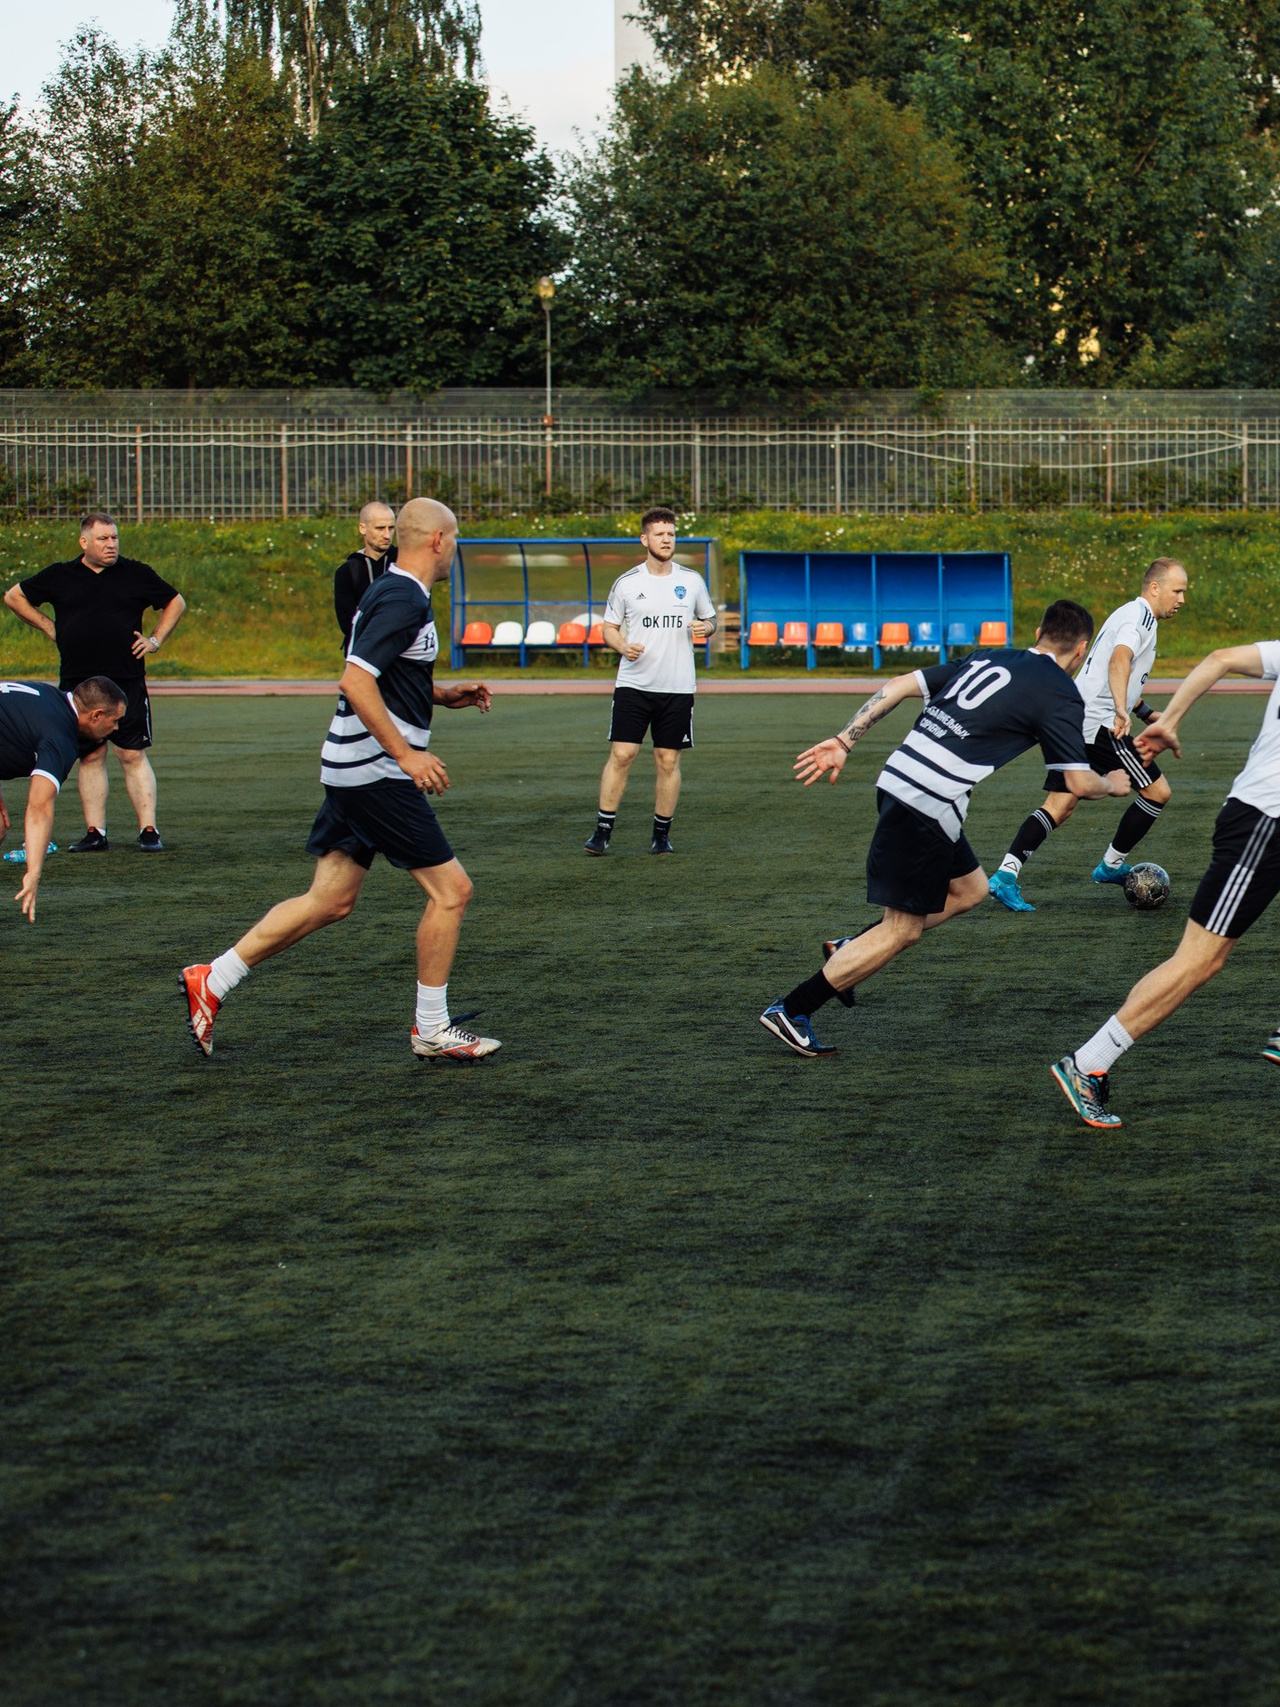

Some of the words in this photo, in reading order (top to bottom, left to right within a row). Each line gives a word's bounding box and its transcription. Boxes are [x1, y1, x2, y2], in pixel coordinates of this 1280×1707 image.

[642, 615, 659, 628] ФК
[662, 615, 683, 628] ПТБ
[943, 658, 1012, 710] 10
